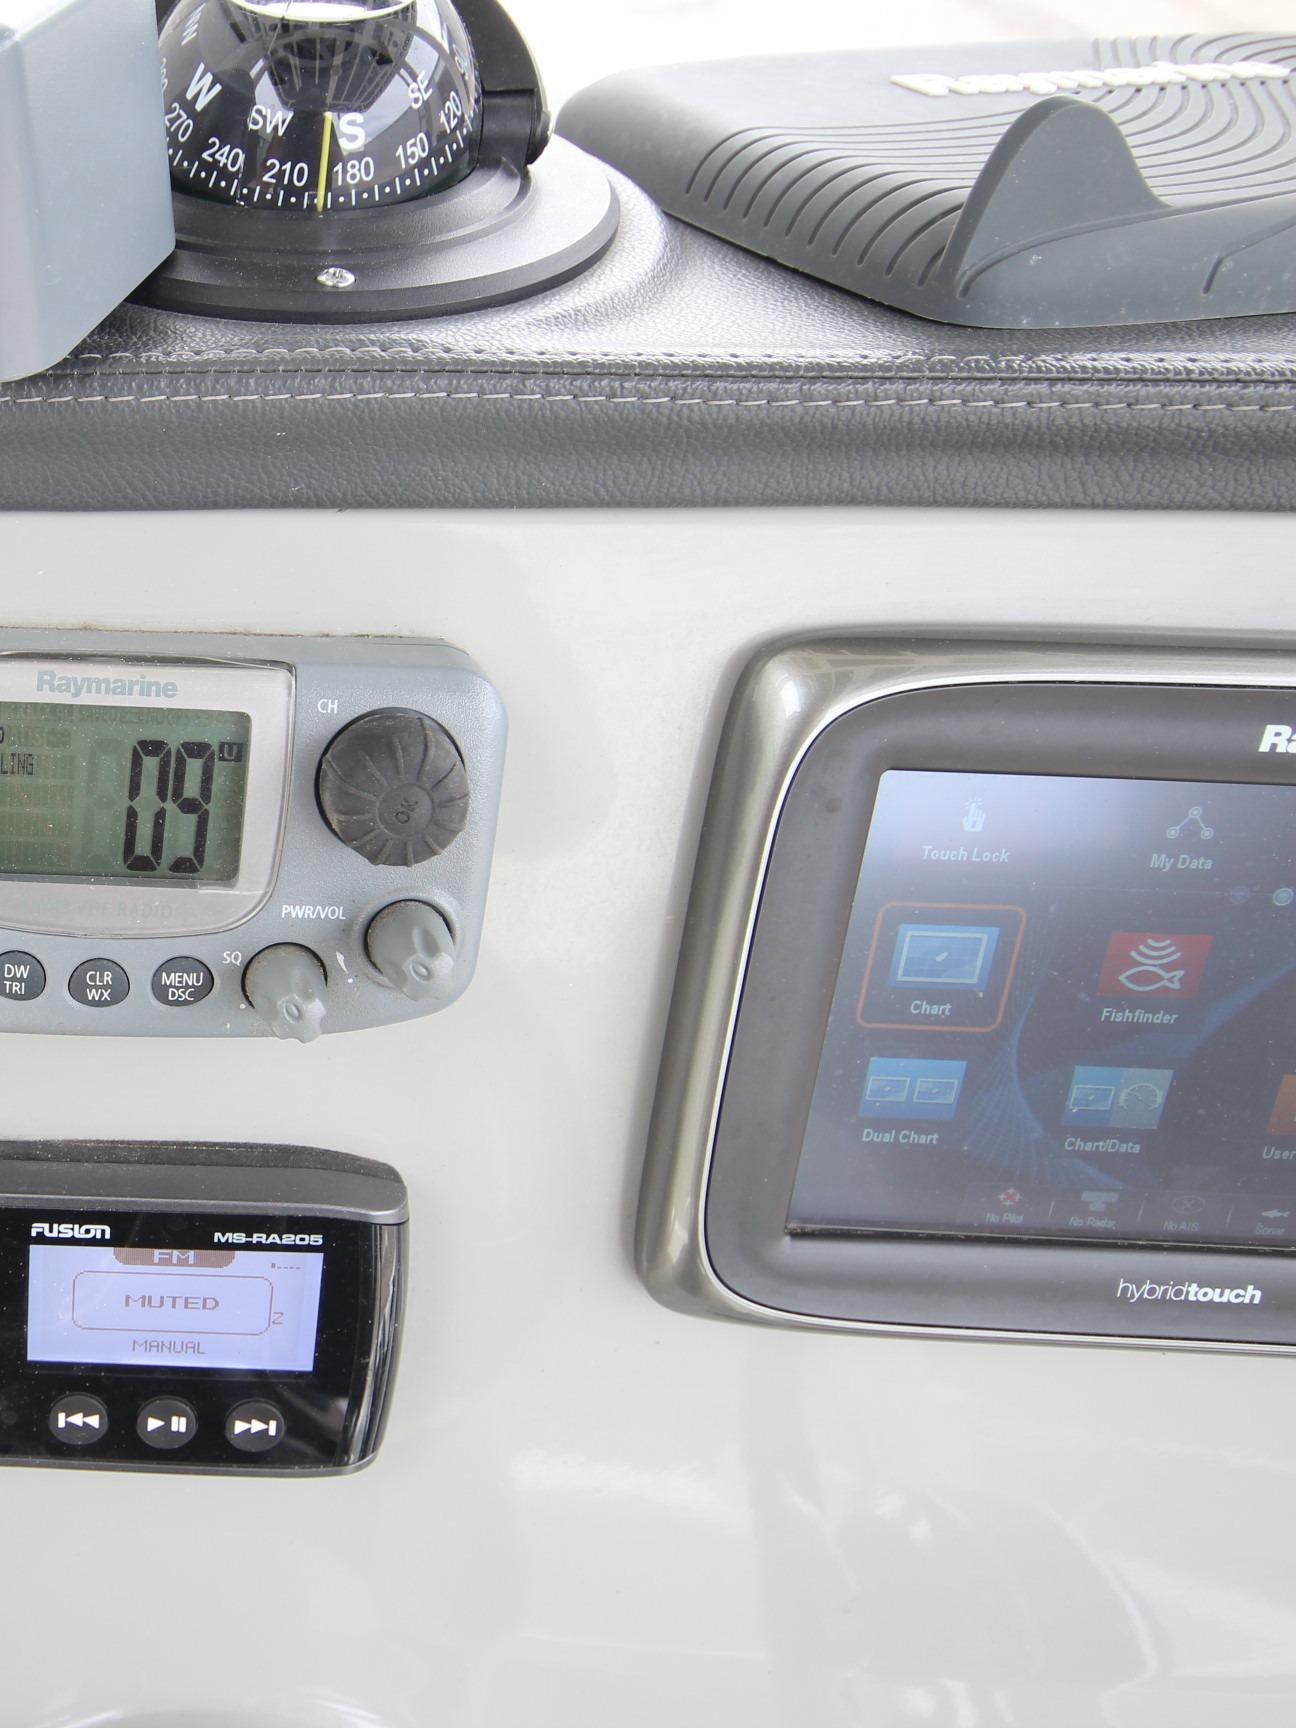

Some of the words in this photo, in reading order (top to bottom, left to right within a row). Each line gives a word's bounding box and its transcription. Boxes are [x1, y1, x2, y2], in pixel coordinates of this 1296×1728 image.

[185, 62, 222, 112] W
[408, 70, 433, 109] SE
[248, 104, 294, 137] SW
[439, 91, 462, 134] 120
[165, 102, 194, 142] 270
[338, 113, 366, 150] S
[201, 137, 244, 172] 240
[395, 132, 429, 168] 150
[262, 159, 308, 187] 210
[333, 156, 375, 185] 180
[36, 670, 178, 699] Raymarine
[317, 699, 338, 714] CH
[123, 740, 216, 874] 09
[922, 845, 966, 863] Touch
[971, 847, 1010, 864] Lock
[1150, 853, 1174, 872] My
[1177, 854, 1213, 870] Data
[281, 904, 347, 920] PWR/VOL
[222, 951, 242, 965] SQ
[3, 963, 29, 979] DW
[85, 970, 113, 986] CLR
[161, 970, 204, 987] MENU
[3, 981, 26, 995] TRI
[86, 987, 111, 1001] WX
[167, 986, 195, 1001] DSC
[910, 1000, 952, 1016] Chart
[1100, 1007, 1179, 1025] Fishfinder
[862, 1128, 895, 1145] Dual
[899, 1130, 939, 1146] Chart
[1064, 1137, 1141, 1154] Chart/Data
[214, 1231, 323, 1246] MS-RA205
[153, 1250, 194, 1265] FM
[1117, 1279, 1262, 1304] hybridtouch
[125, 1294, 219, 1310] MUTED
[132, 1339, 206, 1355] MANUAL
